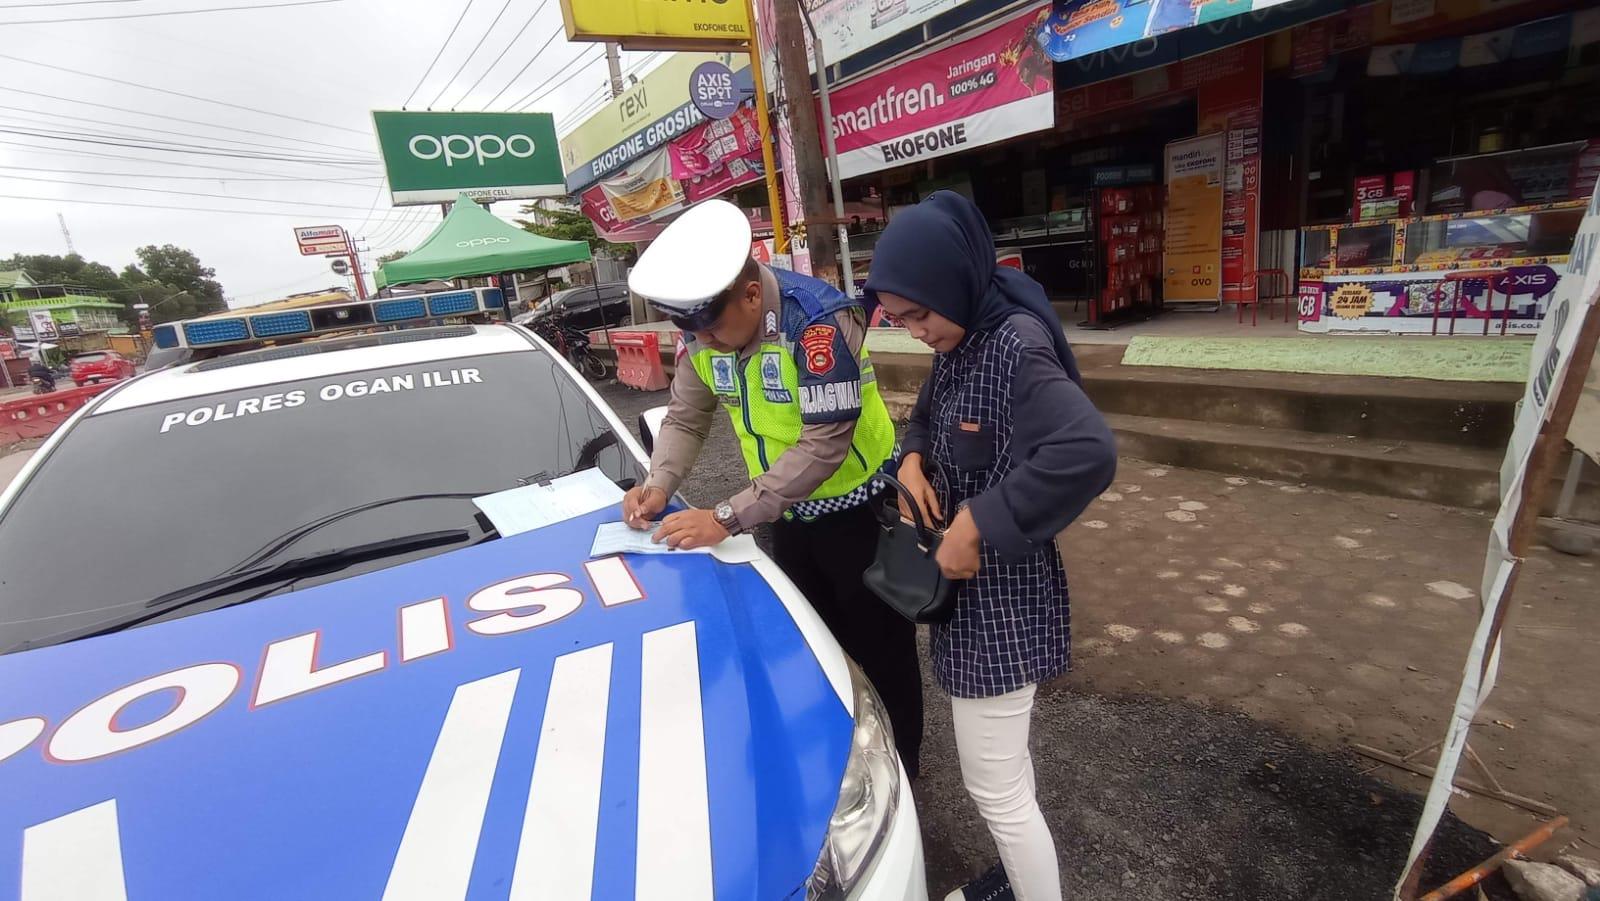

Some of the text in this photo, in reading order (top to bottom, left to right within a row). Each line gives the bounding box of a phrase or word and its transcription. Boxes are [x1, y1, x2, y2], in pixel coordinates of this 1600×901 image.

[694, 23, 745, 33] EKOFONE CELL
[946, 52, 997, 80] Jaringan
[697, 73, 732, 87] AXIS
[950, 72, 995, 97] 100% 4G
[619, 80, 648, 123] rexi
[698, 86, 733, 100] SPOT
[408, 134, 536, 167] oppo
[591, 134, 645, 177] EKOFONE
[646, 103, 703, 146] GROSIR
[880, 123, 968, 164] EKOFONE
[455, 236, 511, 249] oppo
[1191, 278, 1212, 287] OVO
[1499, 273, 1547, 286] AXIS
[1298, 295, 1316, 317] GB
[1336, 295, 1368, 305] 24 JAM
[159, 367, 484, 434] POLRES OGAN ILIR
